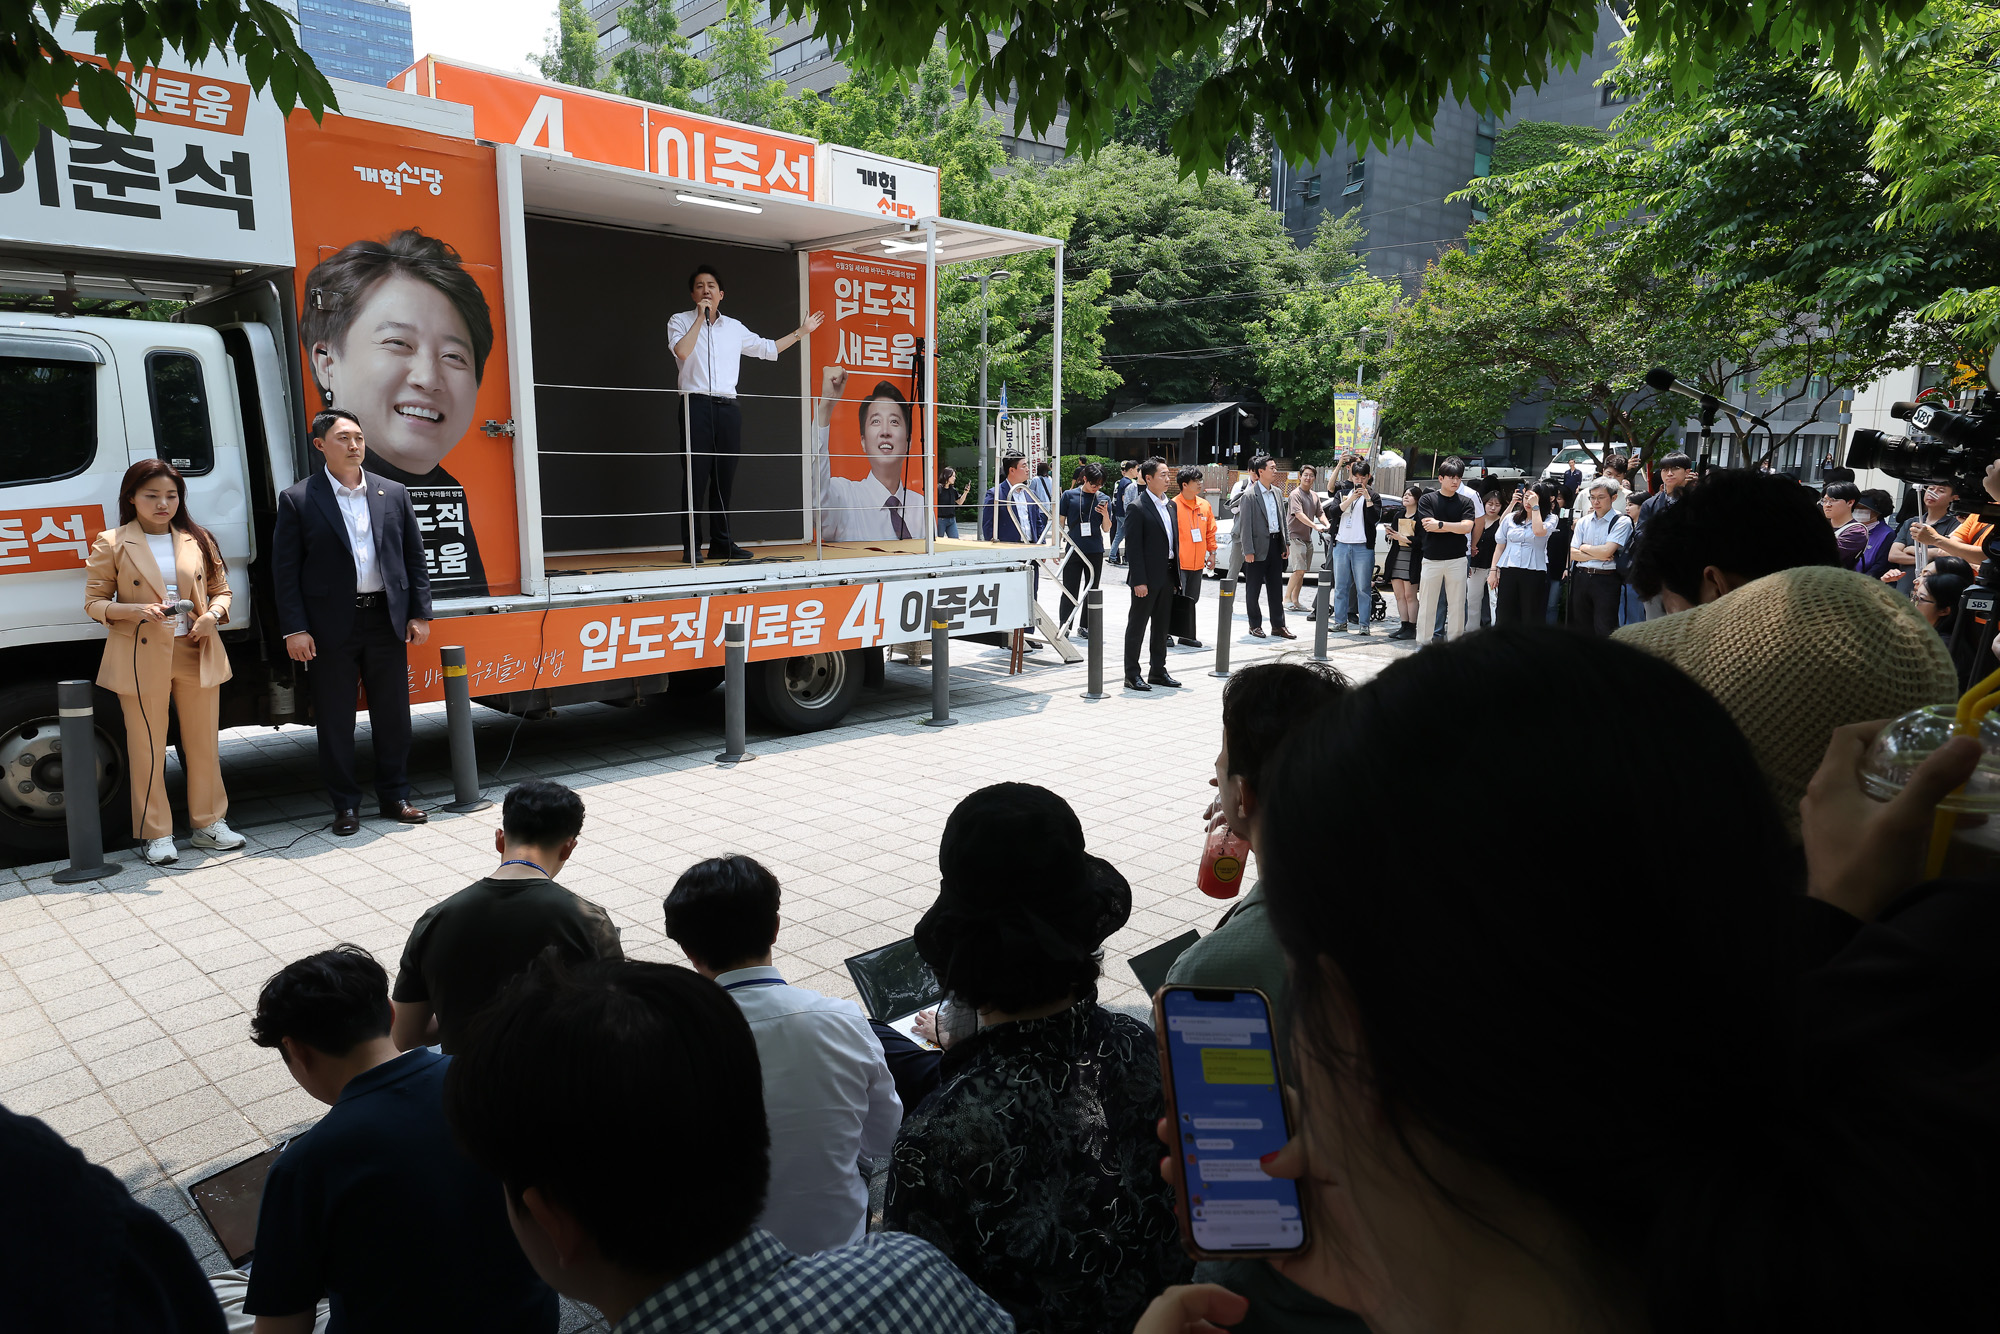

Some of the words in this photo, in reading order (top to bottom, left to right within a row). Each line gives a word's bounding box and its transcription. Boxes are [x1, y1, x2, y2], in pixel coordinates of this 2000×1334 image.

[514, 95, 573, 157] 4
[657, 127, 809, 200] 이준석
[353, 161, 444, 196] 개혁신당
[857, 168, 897, 200] 개혁
[835, 262, 854, 272] 6월3일
[855, 264, 870, 274] 세상을
[870, 267, 886, 276] 바꾸는
[886, 269, 906, 279] 우리들의
[905, 272, 916, 280] 방법
[834, 277, 915, 327] 압도적
[834, 328, 917, 370] 새로움
[1914, 409, 1932, 425] SBS
[429, 490, 451, 498] 우리들의
[451, 490, 463, 498] 방법
[1971, 601, 1988, 609] SBS
[579, 596, 710, 672] 압도적
[713, 599, 826, 663] 새로움
[838, 583, 883, 648] 4
[900, 583, 1001, 633] 이준석
[471, 653, 527, 688] 우리들의
[532, 648, 566, 678] 방법
